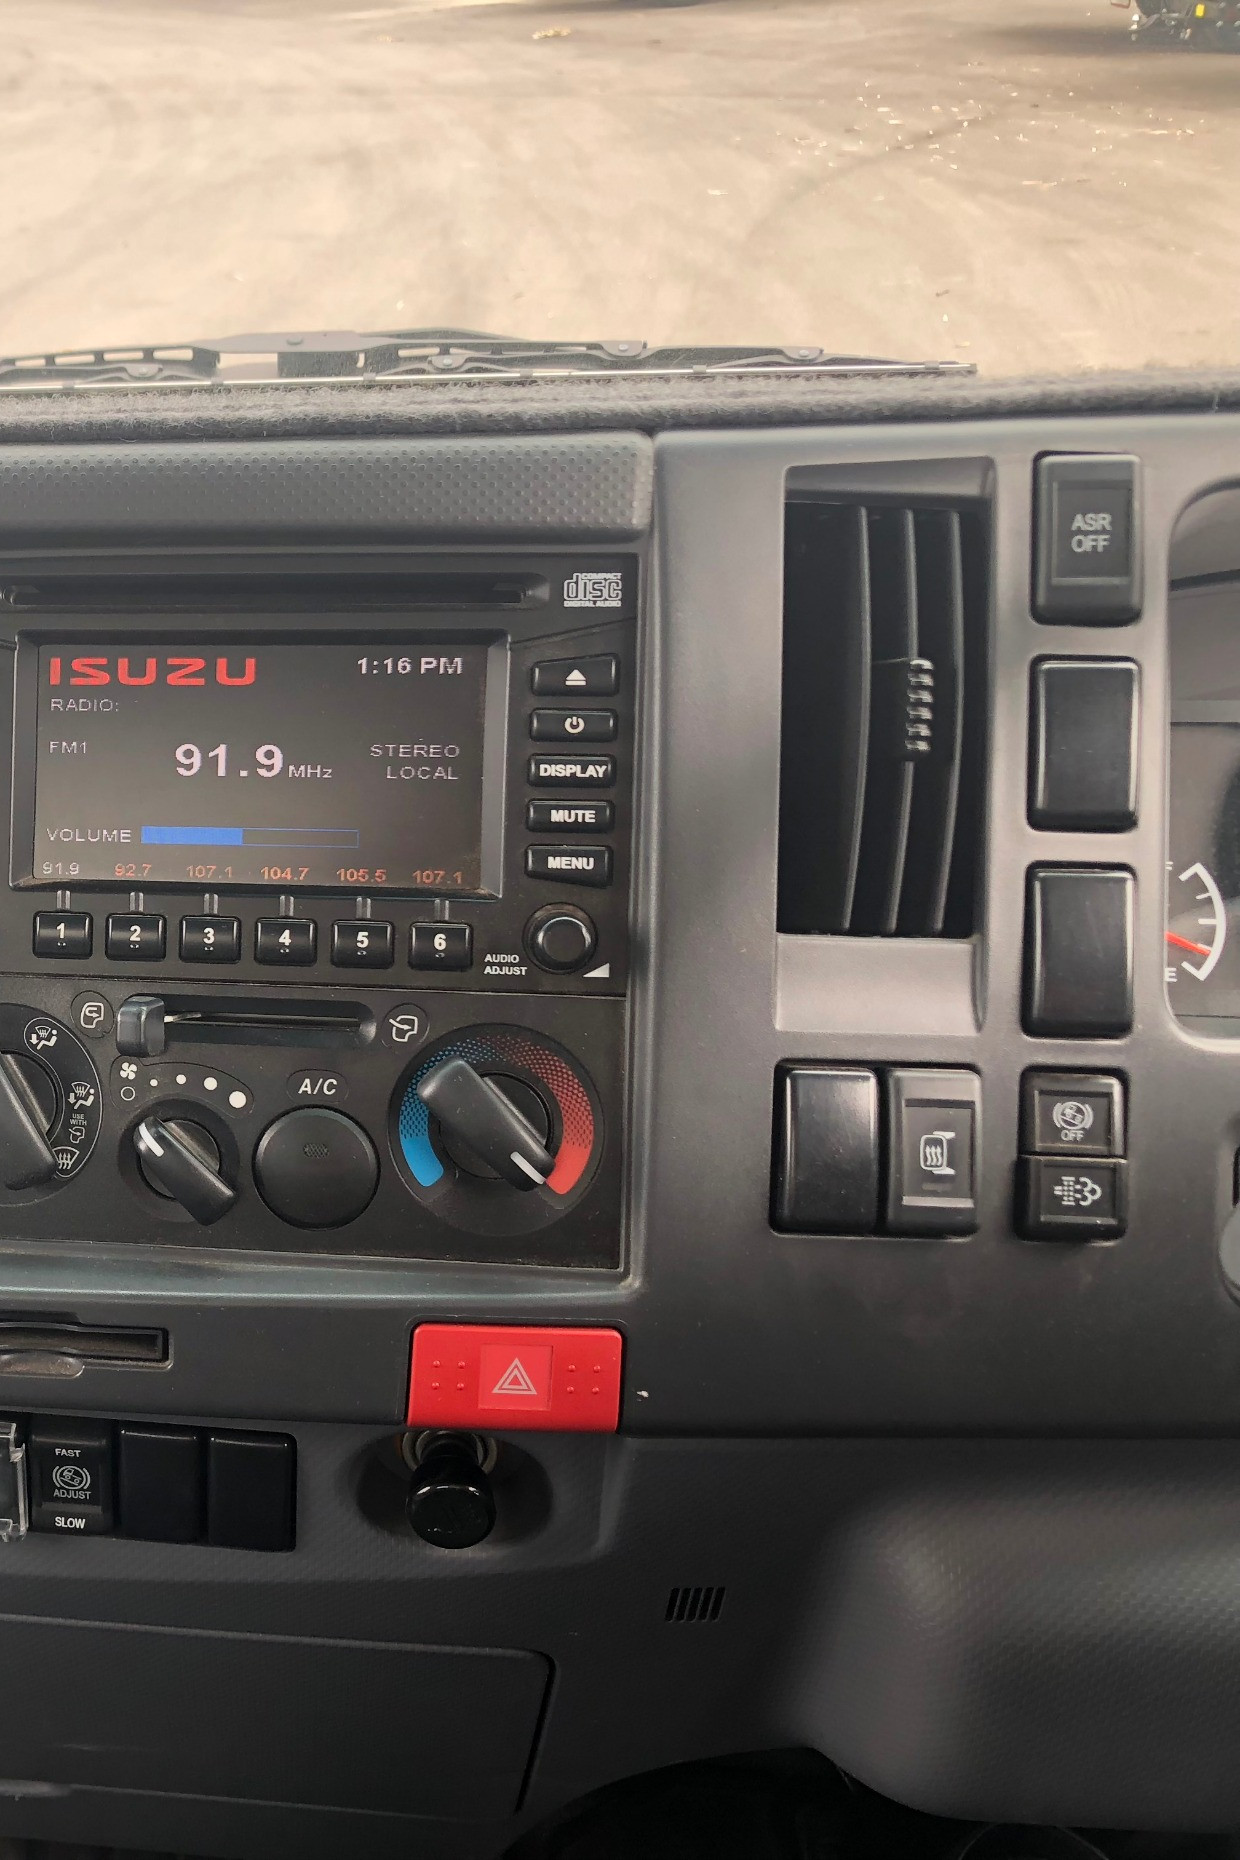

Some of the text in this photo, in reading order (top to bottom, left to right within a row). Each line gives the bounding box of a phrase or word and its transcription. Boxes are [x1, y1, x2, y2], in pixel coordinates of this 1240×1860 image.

[1070, 513, 1112, 531] ASR
[1070, 535, 1111, 552] OFF
[49, 657, 256, 686] ISUZU
[357, 657, 464, 675] 1:16 PM
[50, 698, 119, 712] RADIO:
[49, 741, 87, 754] FM1
[369, 744, 460, 758] STEREO
[175, 743, 333, 778] 91.9 MHz
[386, 766, 459, 780] LOCAL
[539, 764, 607, 778] DISPLAY
[550, 809, 596, 823] MUTE
[46, 828, 132, 843] VOLUME
[547, 856, 594, 870] MENU
[42, 861, 462, 884] 91.9 92.7 107.1 104.7 105.5 107.1
[56, 922, 66, 939] 1
[129, 925, 141, 941] 2
[203, 927, 215, 944] 3
[278, 929, 291, 946] 4
[356, 931, 369, 948] 5
[433, 933, 447, 950] 6
[484, 953, 519, 963] AUDIO
[484, 965, 527, 976] ADJUST
[1164, 967, 1178, 982] E
[297, 1078, 338, 1095] A/C
[1060, 1129, 1085, 1141] OFF
[55, 1448, 81, 1458] FAST
[53, 1488, 91, 1500] ADJUST
[54, 1516, 86, 1529] SLOW
